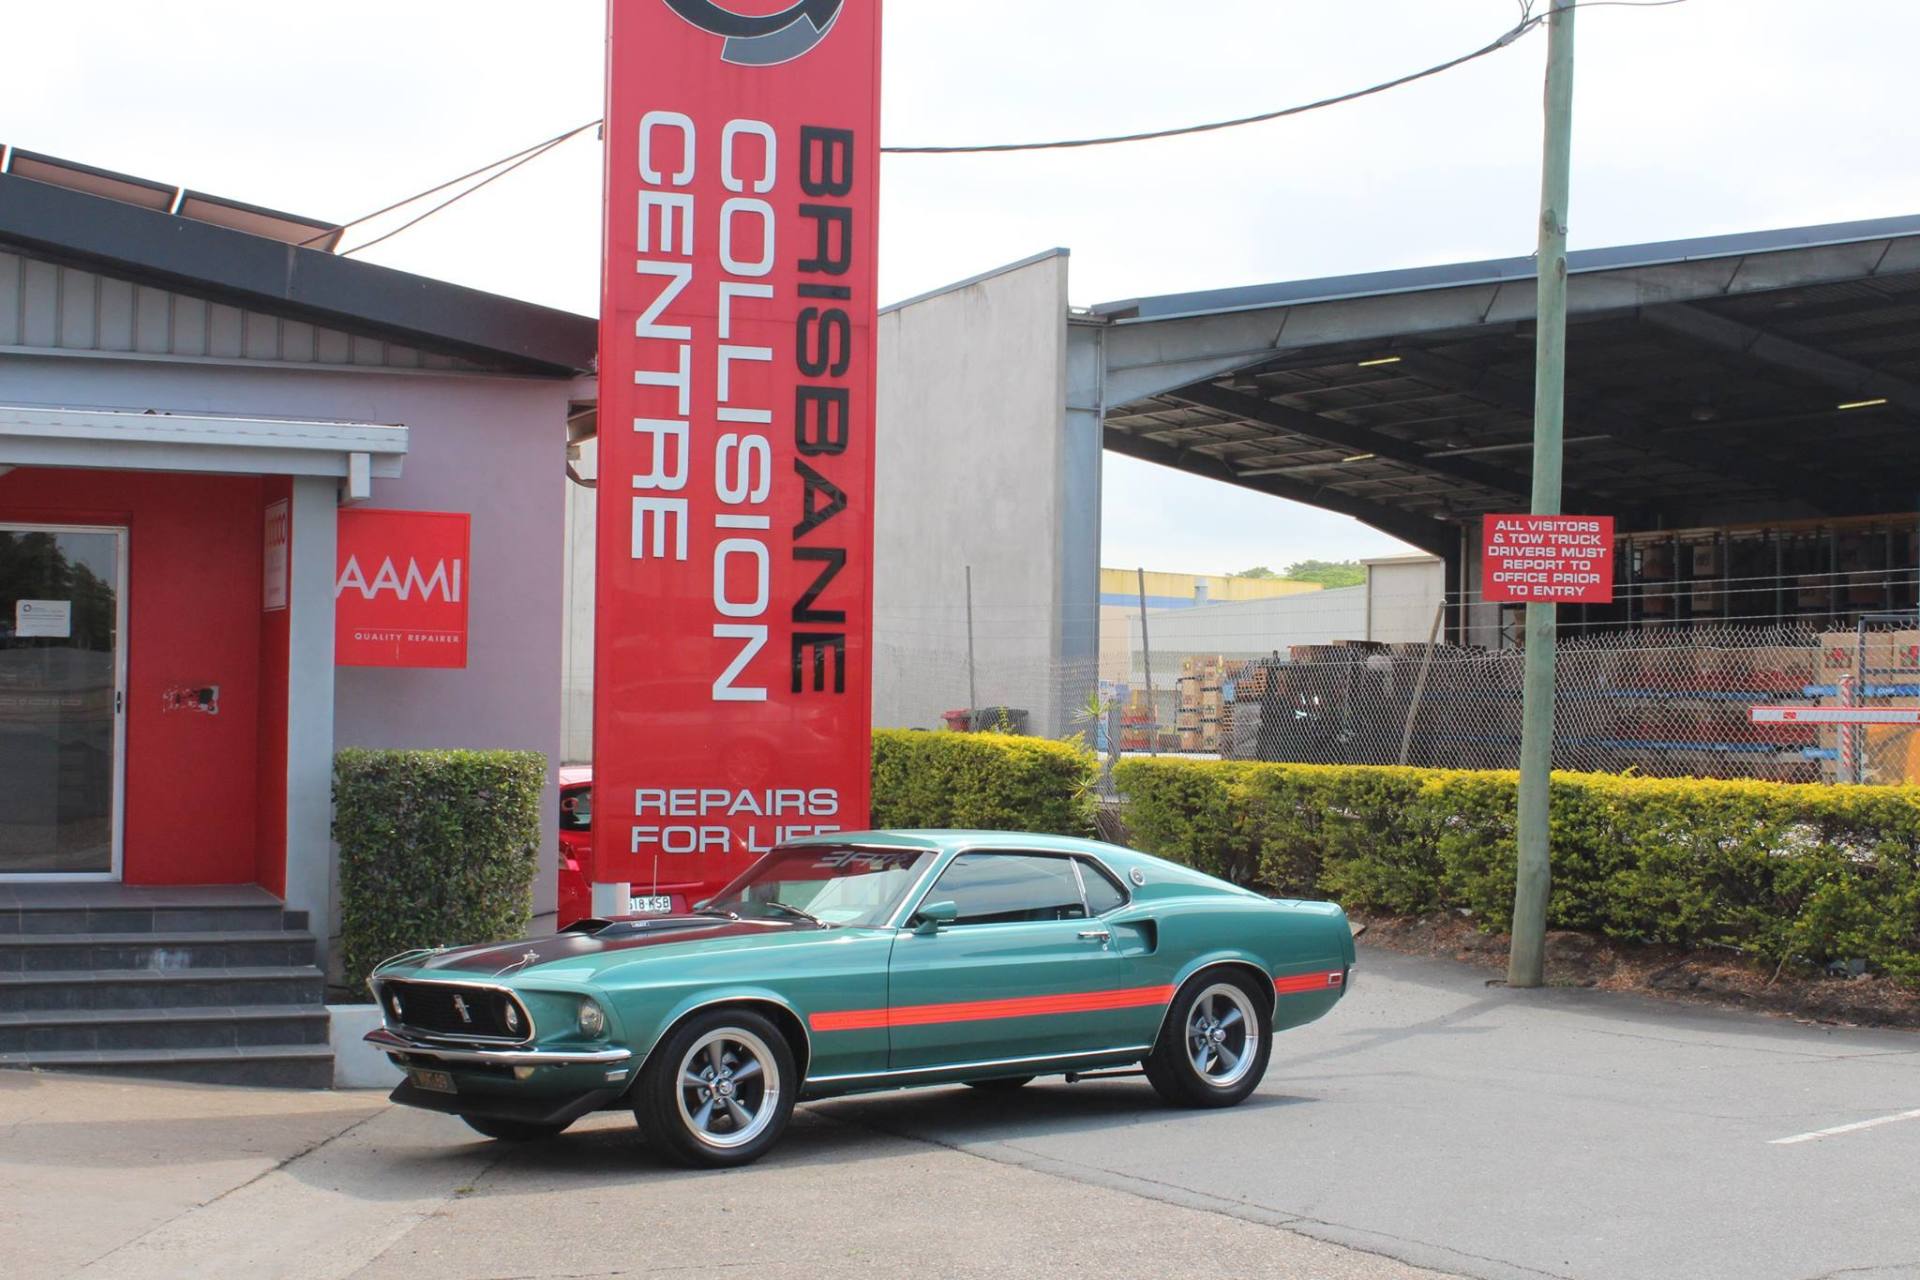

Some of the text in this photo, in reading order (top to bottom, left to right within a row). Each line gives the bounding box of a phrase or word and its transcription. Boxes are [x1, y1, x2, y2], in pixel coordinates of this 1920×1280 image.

[631, 111, 695, 561] CENTRE
[712, 119, 776, 701] COLLISION
[791, 125, 854, 694] BRISBANE
[1496, 521, 1599, 532] ALL VISITORS
[1493, 533, 1601, 545] & TOW TRUCK
[1488, 546, 1607, 558] DRIVERS MUST
[1503, 560, 1591, 570] REPORT TO
[336, 554, 461, 602] AAMI
[1493, 572, 1600, 584] OFFICE PRIOR
[1507, 585, 1585, 596] TO ENTRY
[354, 632, 459, 643] QUALITY REPAIRER
[634, 788, 839, 816] REPAIRS
[631, 826, 730, 853] FOR
